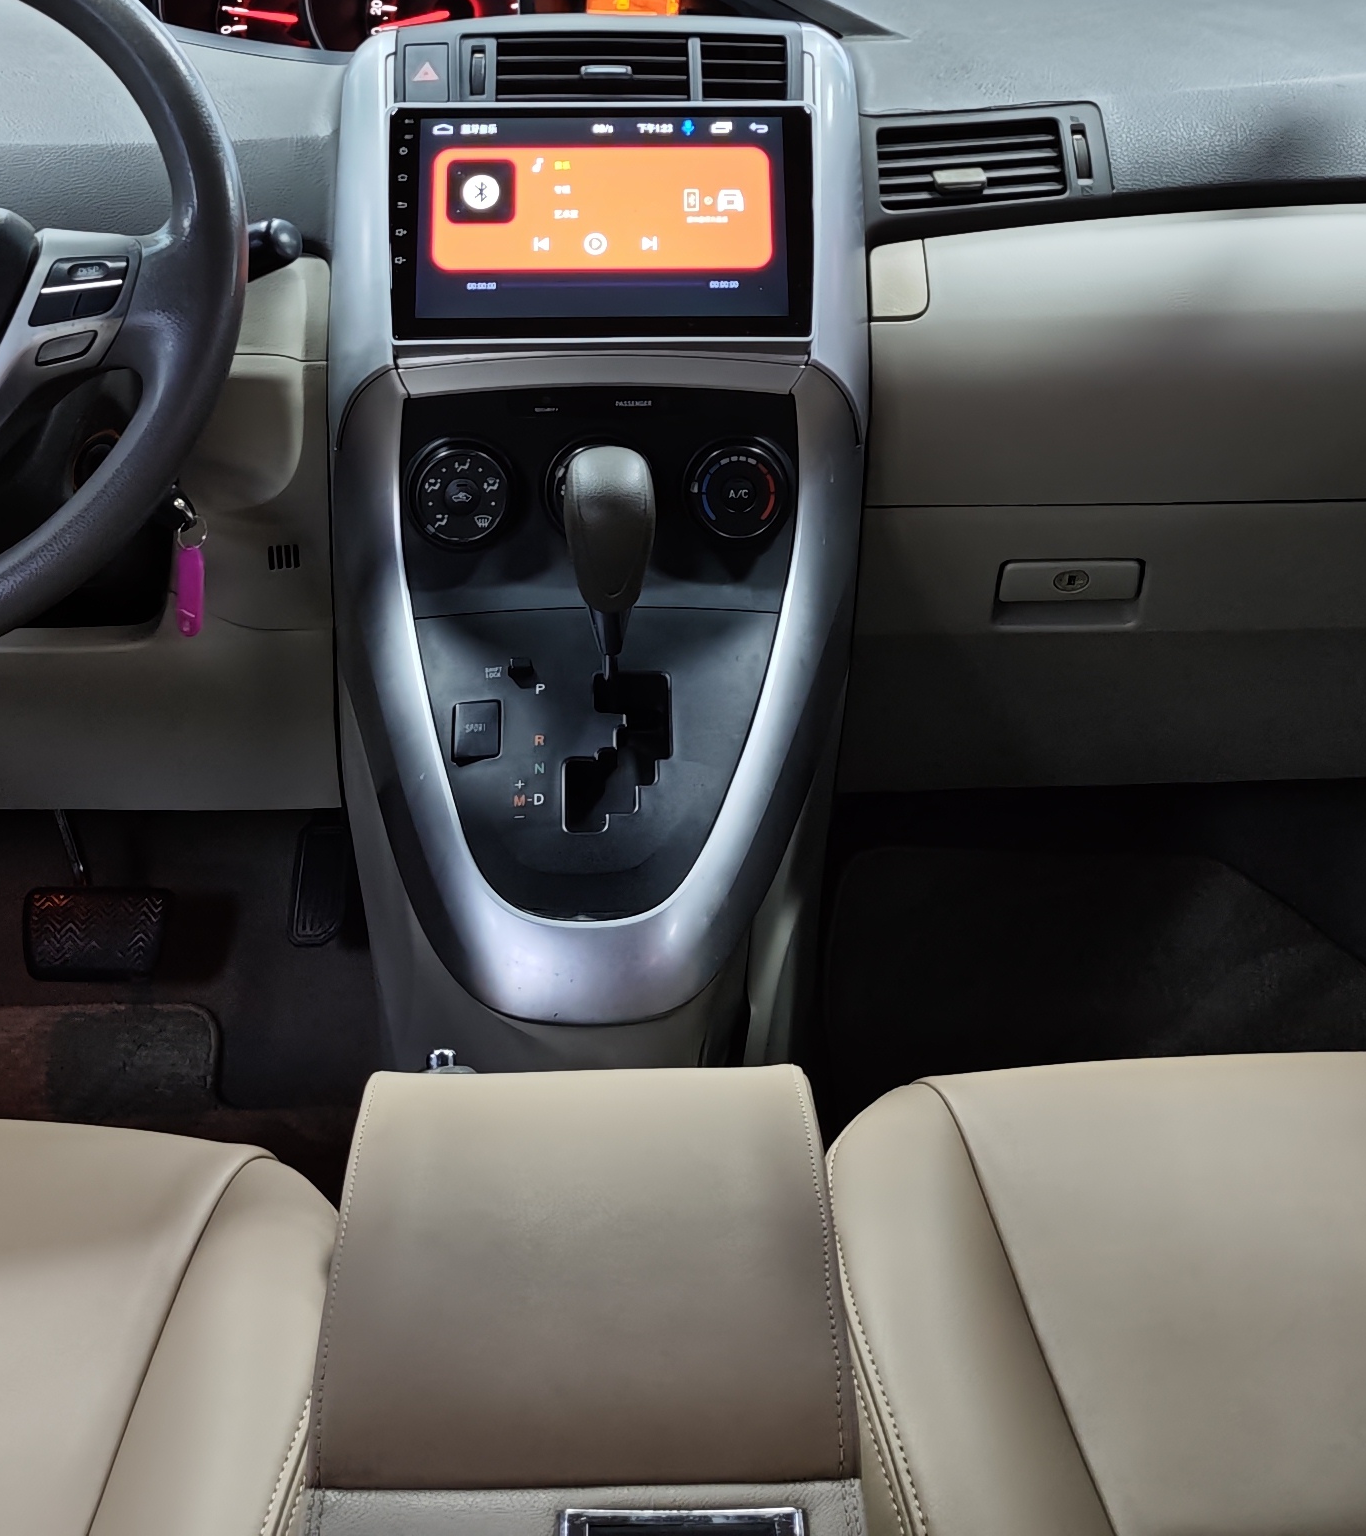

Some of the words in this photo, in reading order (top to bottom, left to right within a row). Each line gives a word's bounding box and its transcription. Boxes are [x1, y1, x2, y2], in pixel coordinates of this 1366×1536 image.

[370, 0, 383, 16] 20
[220, 25, 232, 35] 0
[728, 489, 749, 499] A/C
[535, 683, 546, 695] P
[465, 723, 486, 733] SPORT
[534, 734, 545, 746] R
[534, 763, 545, 775] N
